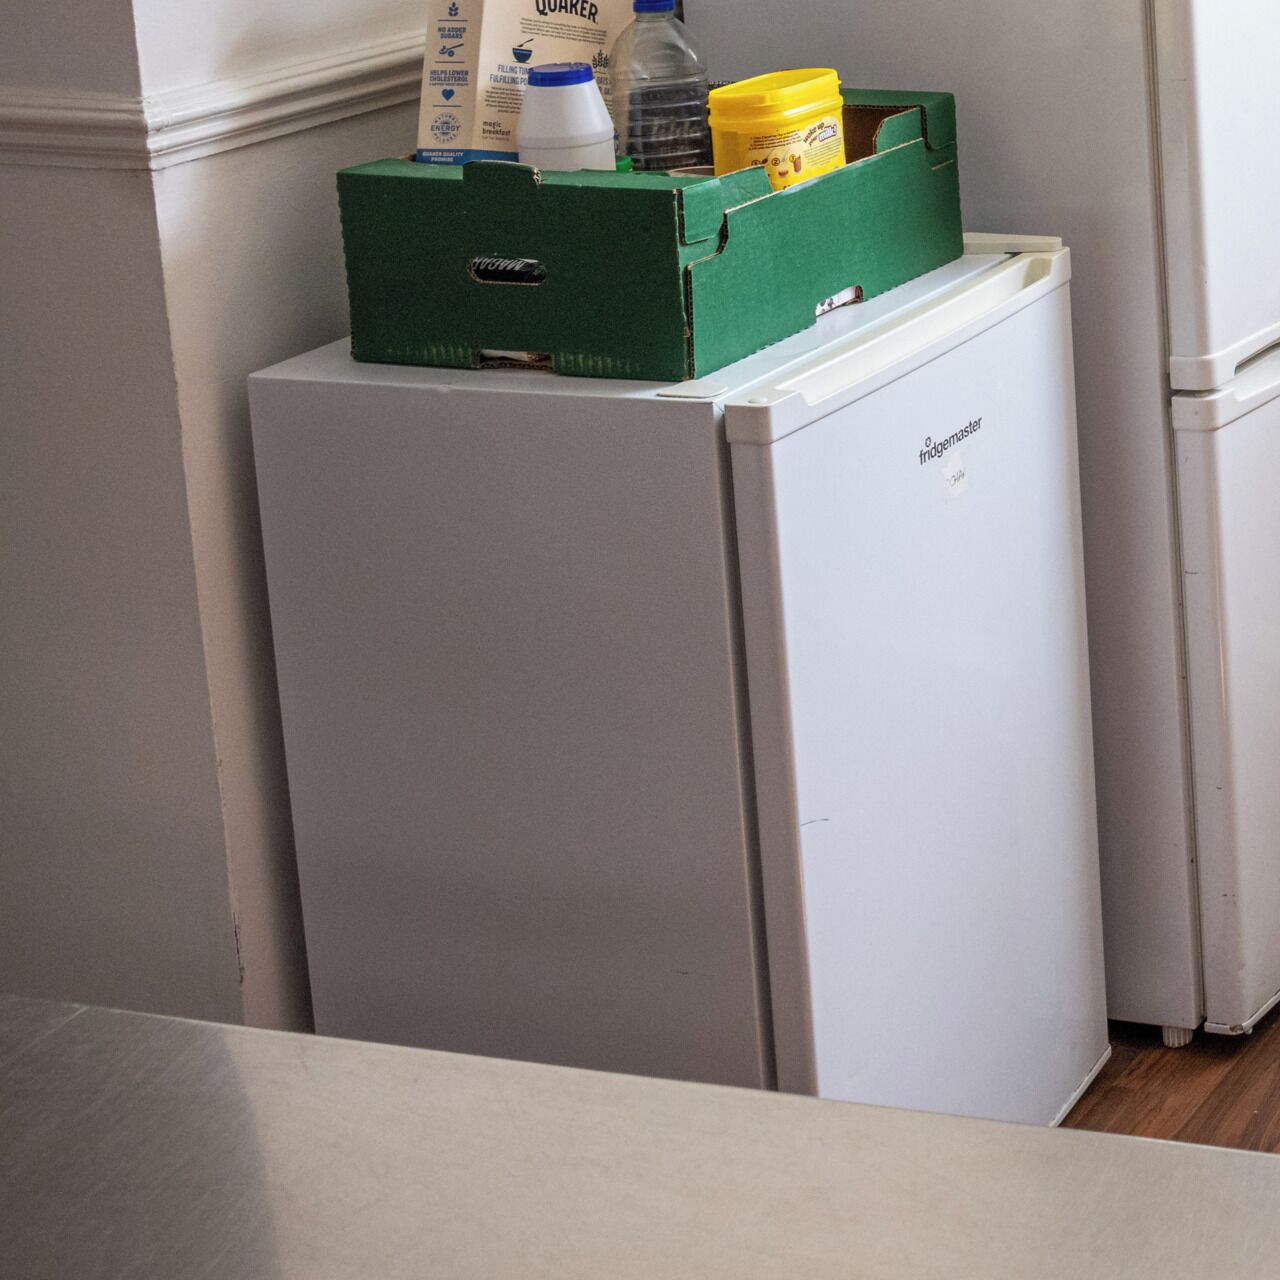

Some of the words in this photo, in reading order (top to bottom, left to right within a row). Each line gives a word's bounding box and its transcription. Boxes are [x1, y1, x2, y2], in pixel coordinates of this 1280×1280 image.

[497, 64, 518, 74] FILLING
[489, 73, 520, 85] FULFILLING
[919, 417, 983, 465] fridgemaster
